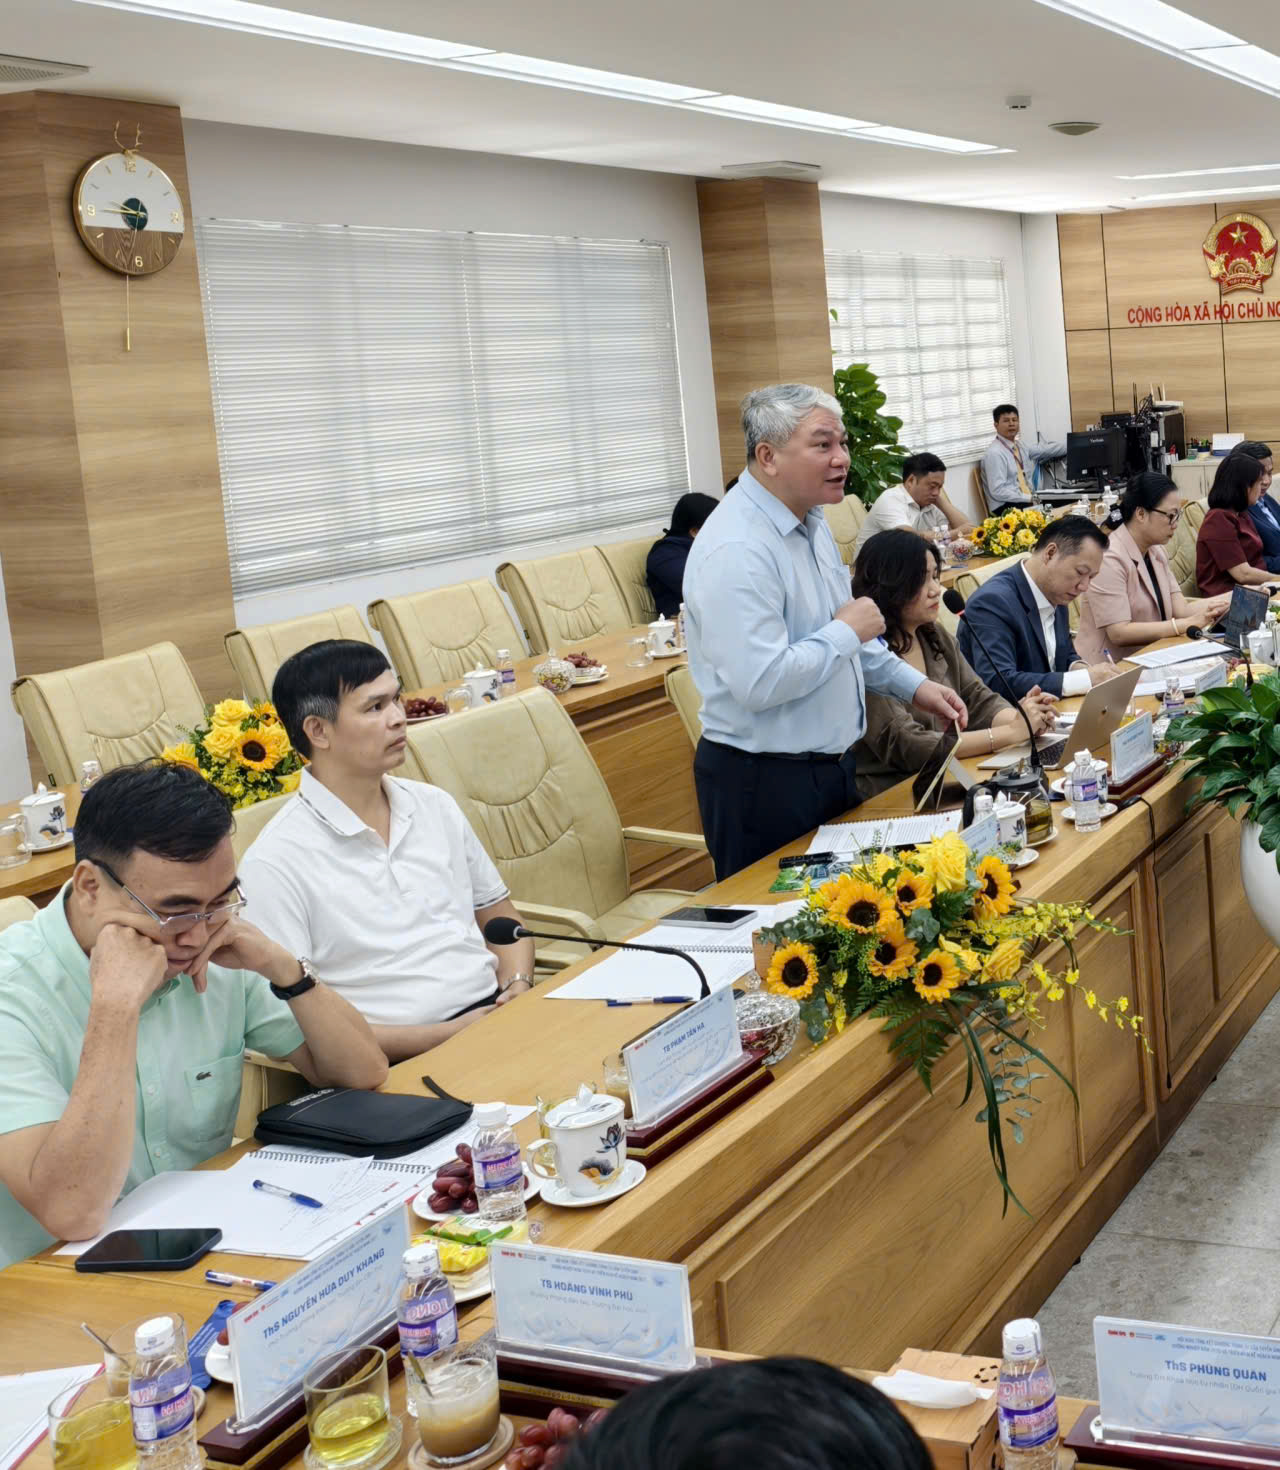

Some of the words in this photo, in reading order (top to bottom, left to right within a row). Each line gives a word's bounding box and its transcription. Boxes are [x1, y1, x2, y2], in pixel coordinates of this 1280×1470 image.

[135, 255, 144, 268] 6
[1128, 304, 1162, 327] CỘNG
[1165, 302, 1191, 322] HÒA
[1194, 301, 1210, 321] XÃ
[1214, 303, 1235, 324] HỘI
[1238, 298, 1263, 319] CHỦ
[263, 1321, 281, 1339] ThS
[356, 1248, 385, 1273] KHANG
[1165, 1360, 1187, 1372] ThS
